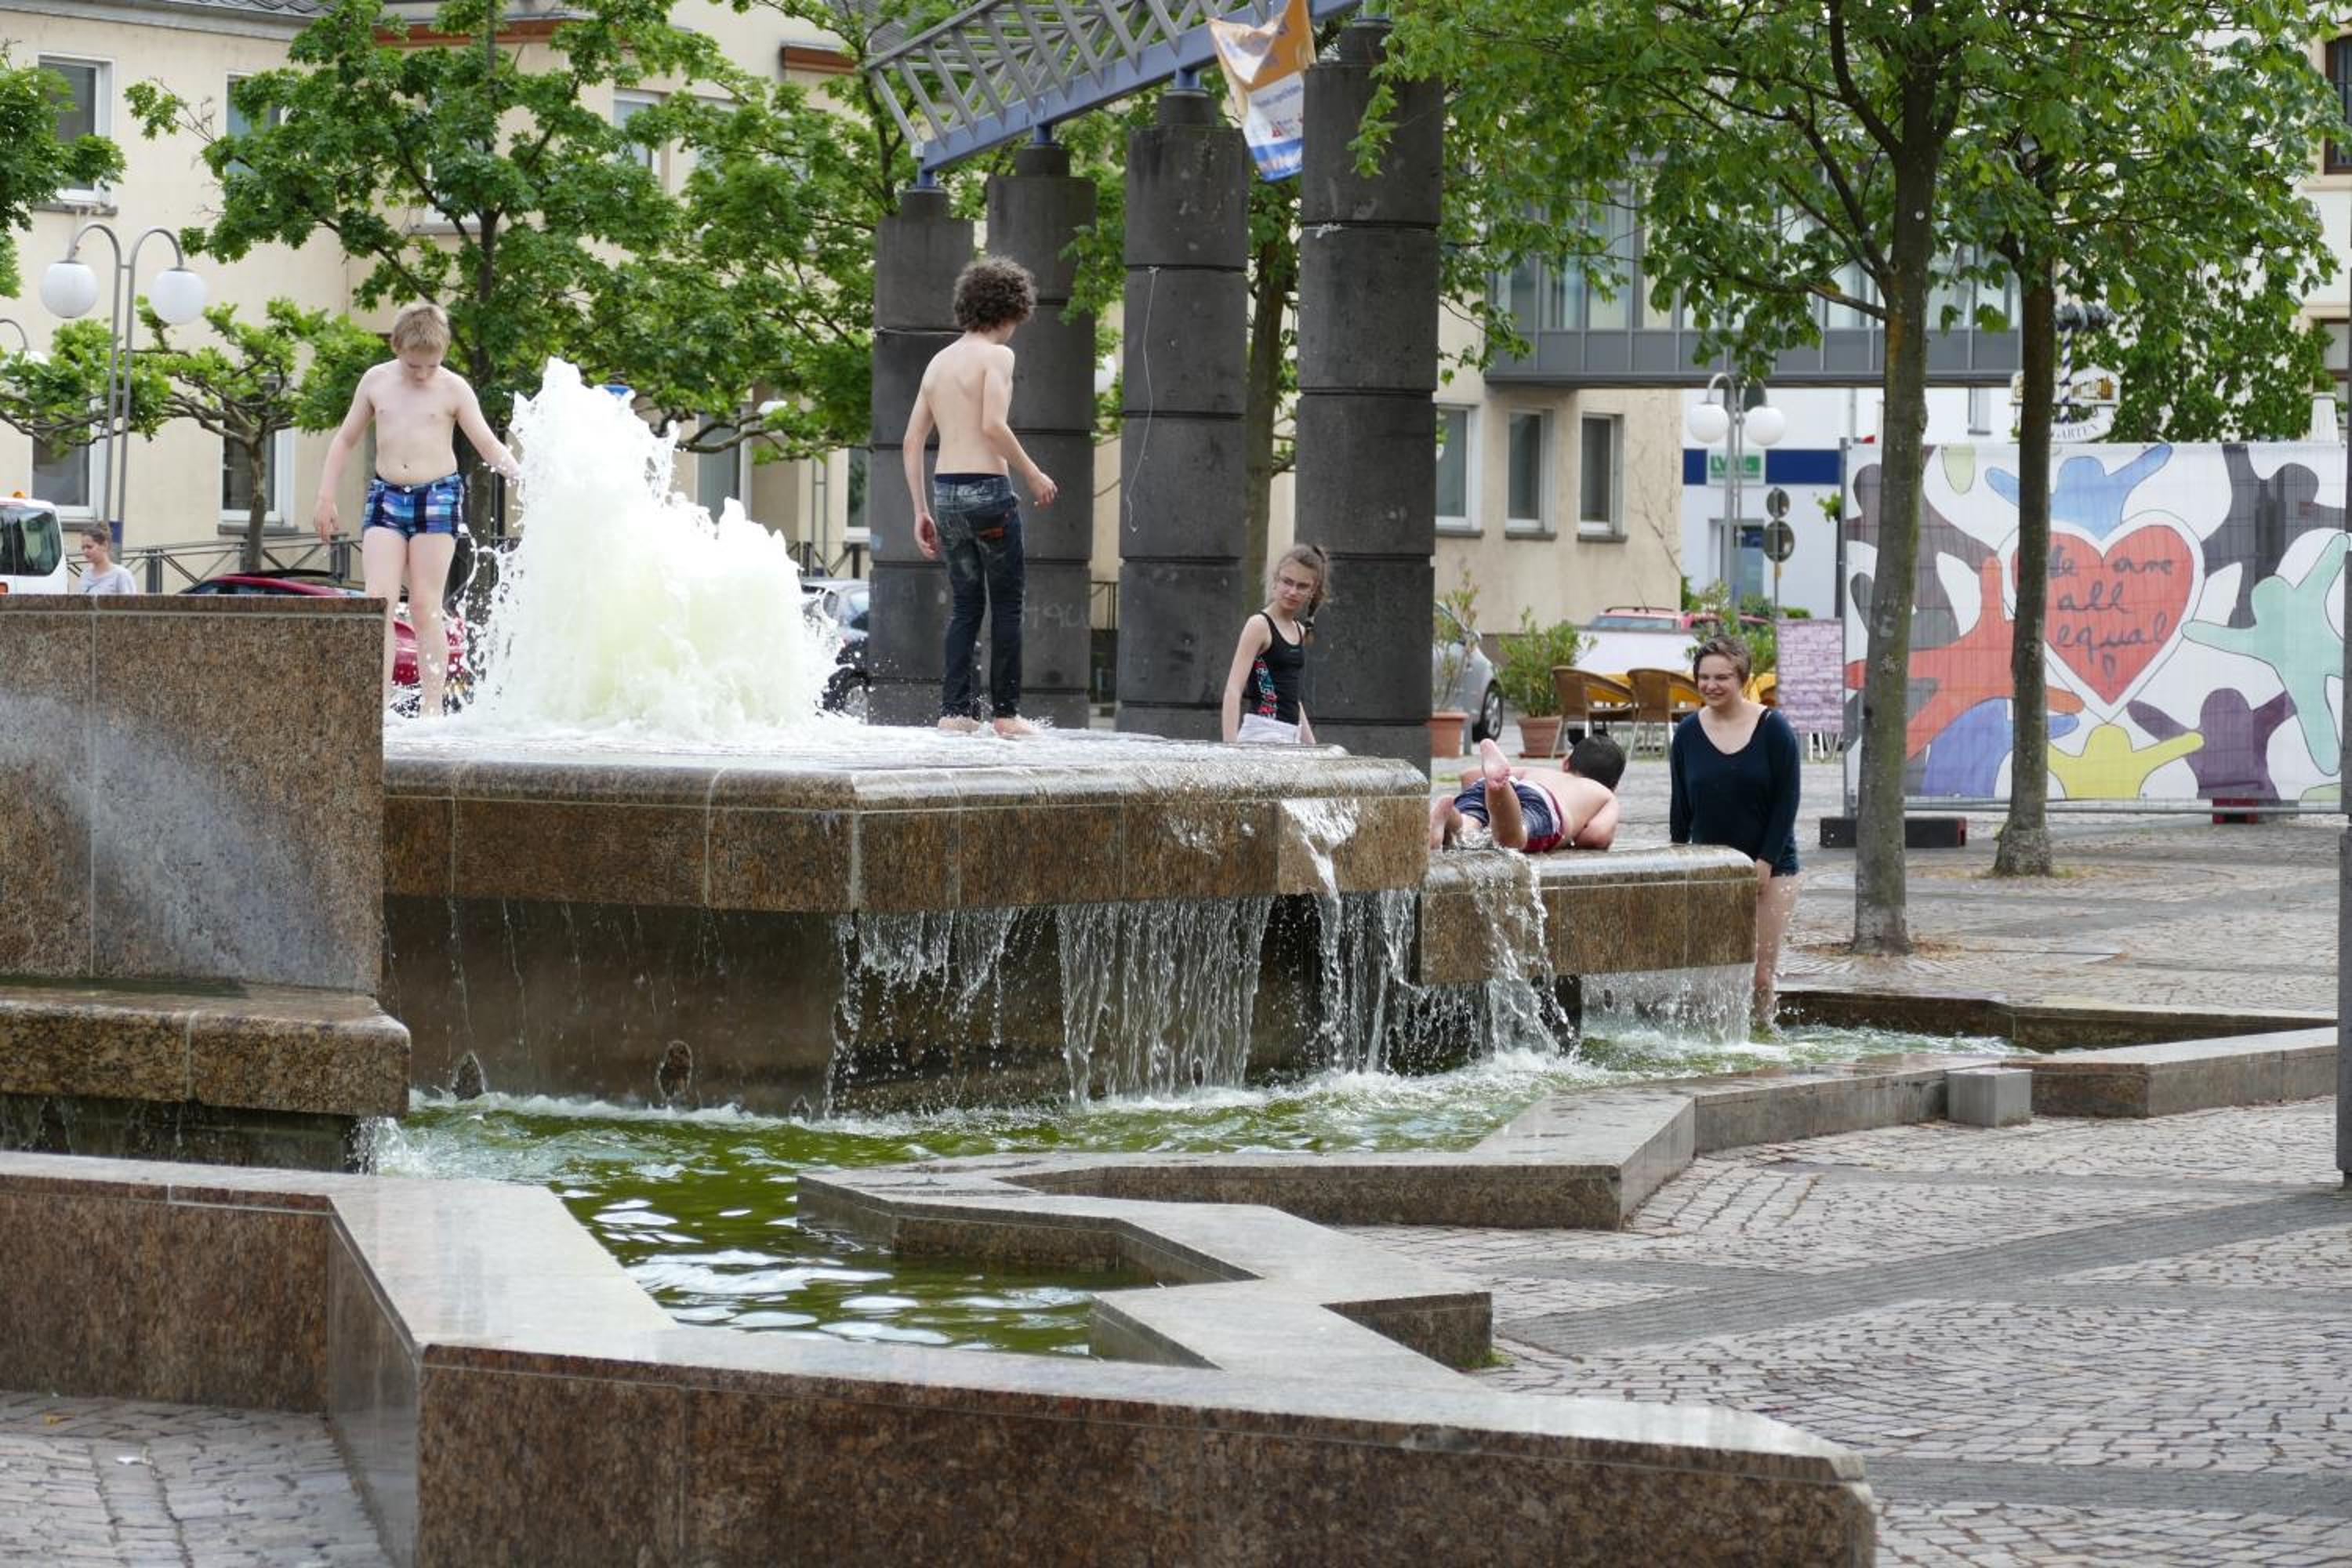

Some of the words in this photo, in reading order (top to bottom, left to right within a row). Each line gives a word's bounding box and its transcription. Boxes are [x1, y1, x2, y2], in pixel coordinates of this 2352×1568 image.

[2112, 558, 2172, 575] are
[2057, 580, 2129, 613] all
[2056, 611, 2168, 665] equal
